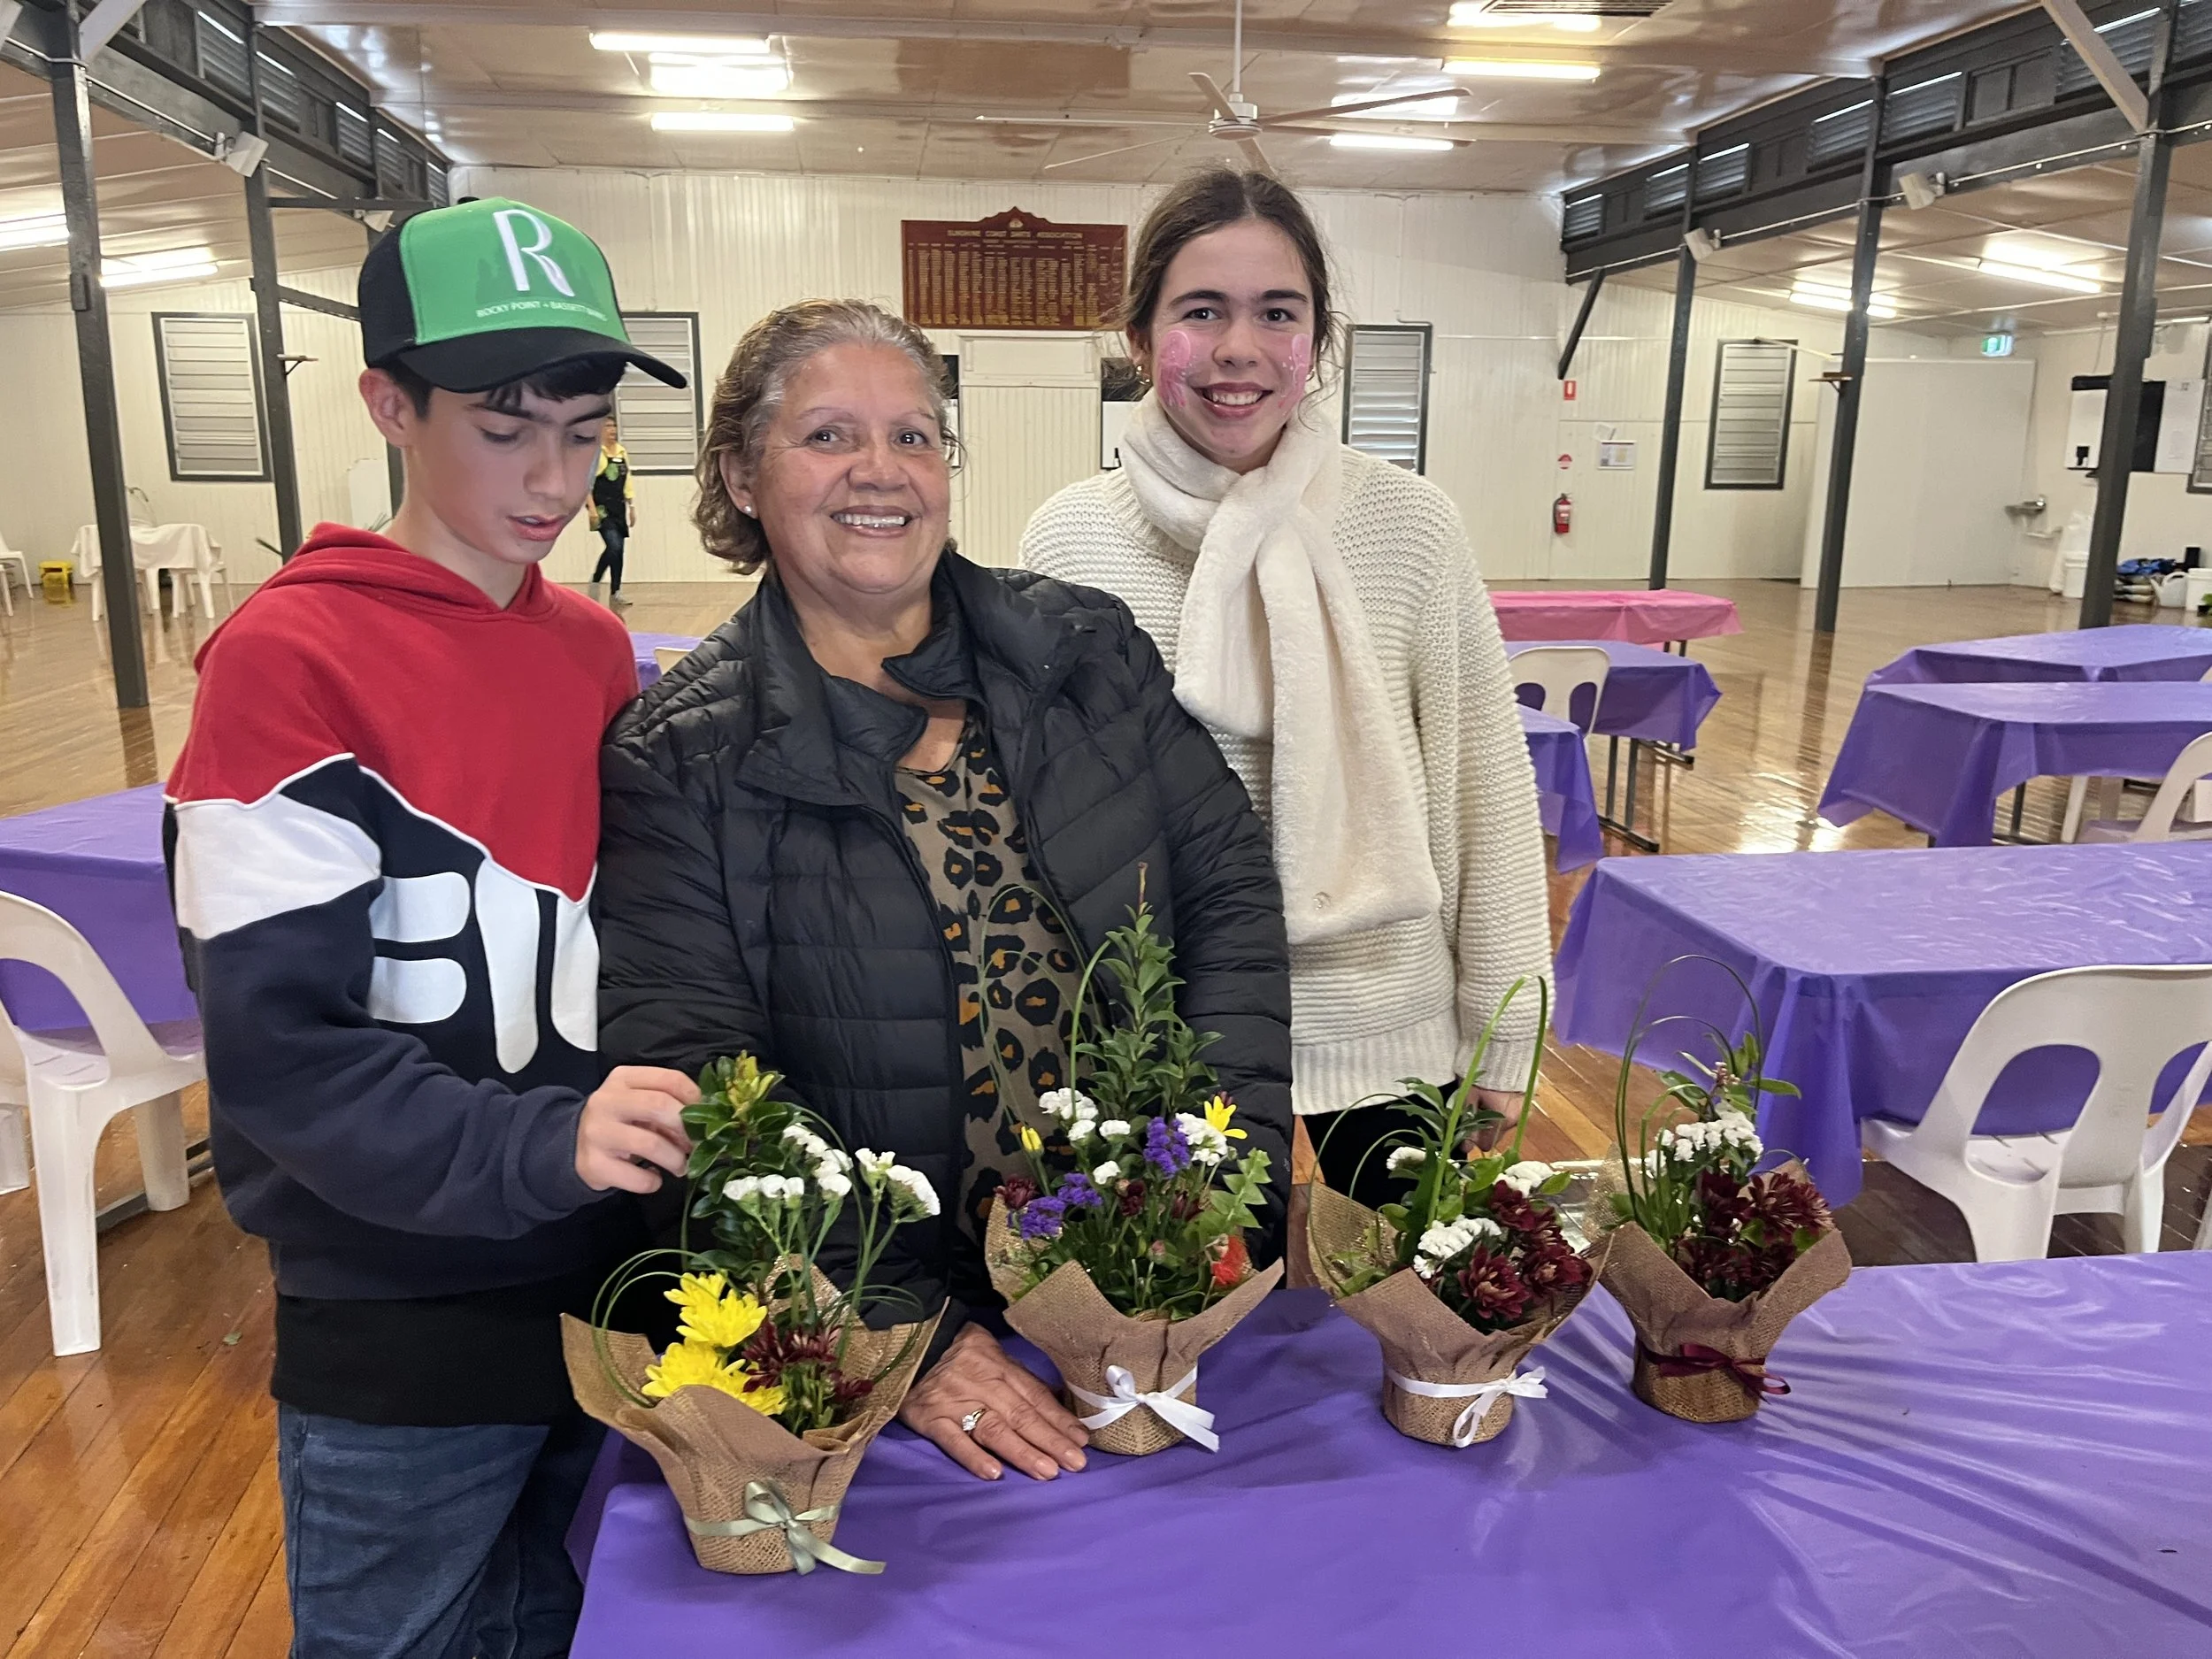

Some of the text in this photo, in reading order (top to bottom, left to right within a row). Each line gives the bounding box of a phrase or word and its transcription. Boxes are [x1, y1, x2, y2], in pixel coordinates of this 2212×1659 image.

[493, 209, 575, 297] R
[476, 303, 510, 318] ROCKY
[511, 301, 541, 311] POINT
